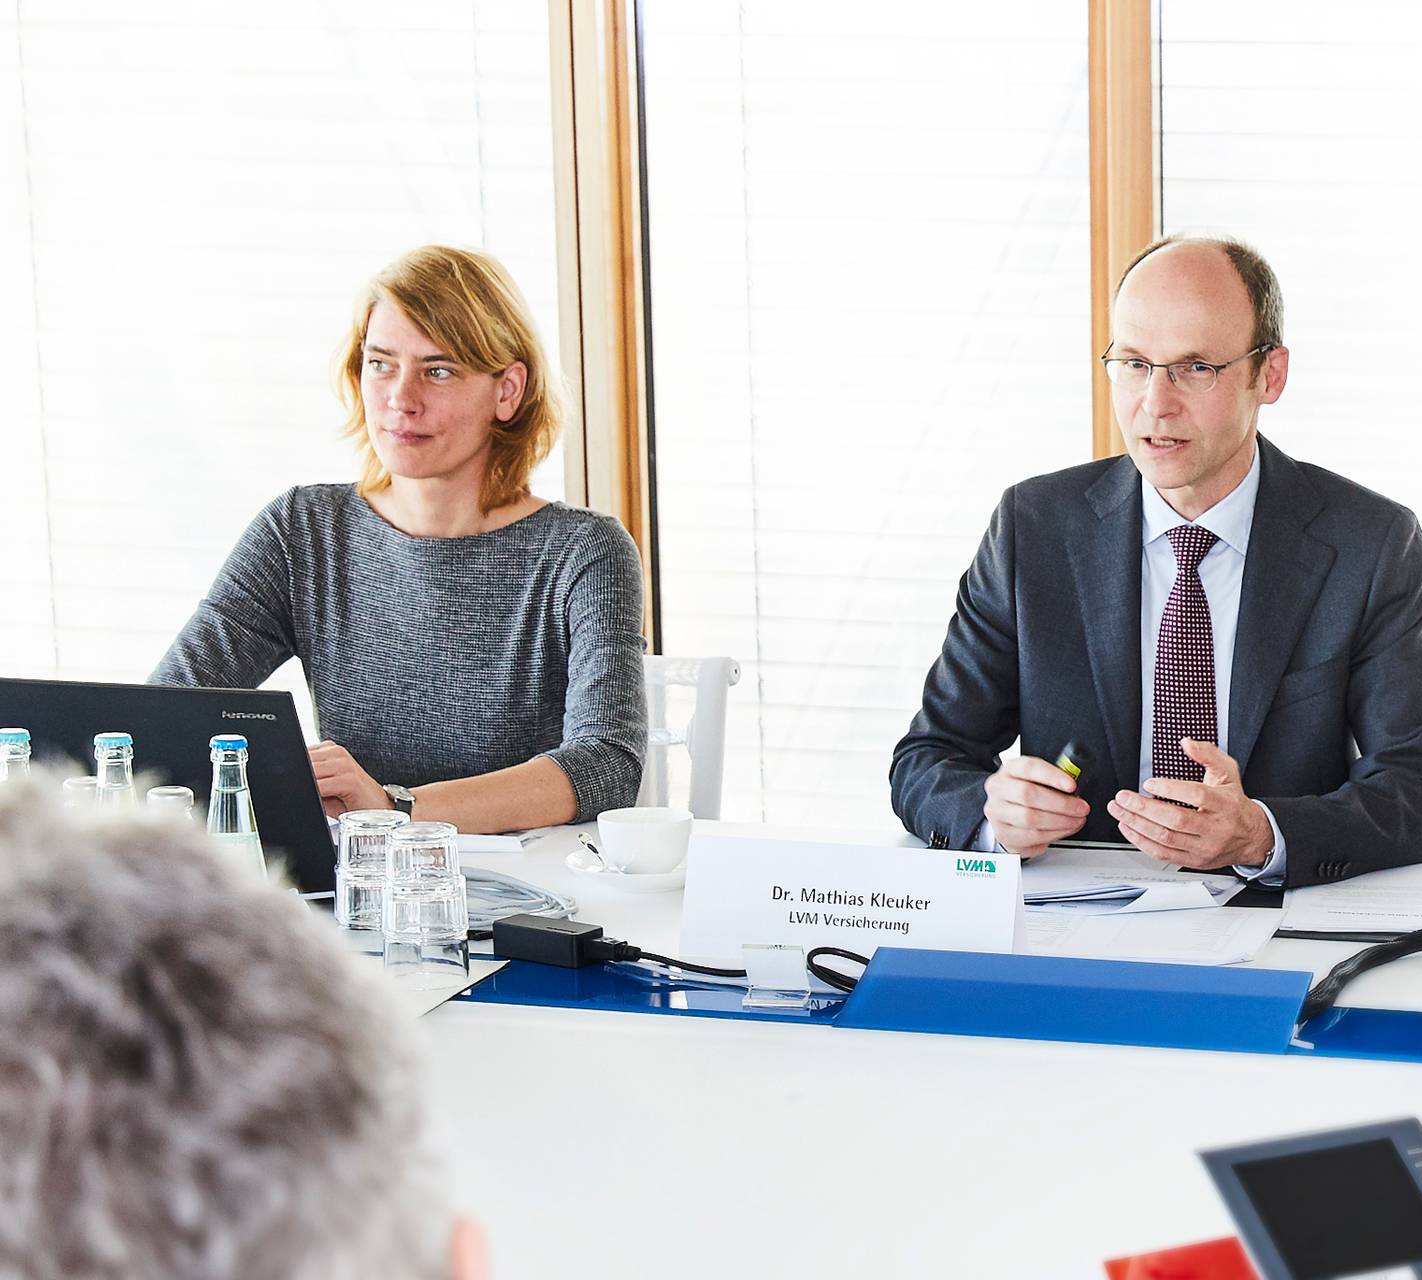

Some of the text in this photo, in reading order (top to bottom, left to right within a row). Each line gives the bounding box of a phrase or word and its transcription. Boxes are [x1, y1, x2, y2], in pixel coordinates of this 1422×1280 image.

[221, 710, 277, 721] lenovo
[956, 858, 984, 872] LVM
[772, 885, 931, 911] Dr. Mathias Kleuker
[789, 910, 910, 935] LVM Versicherung
